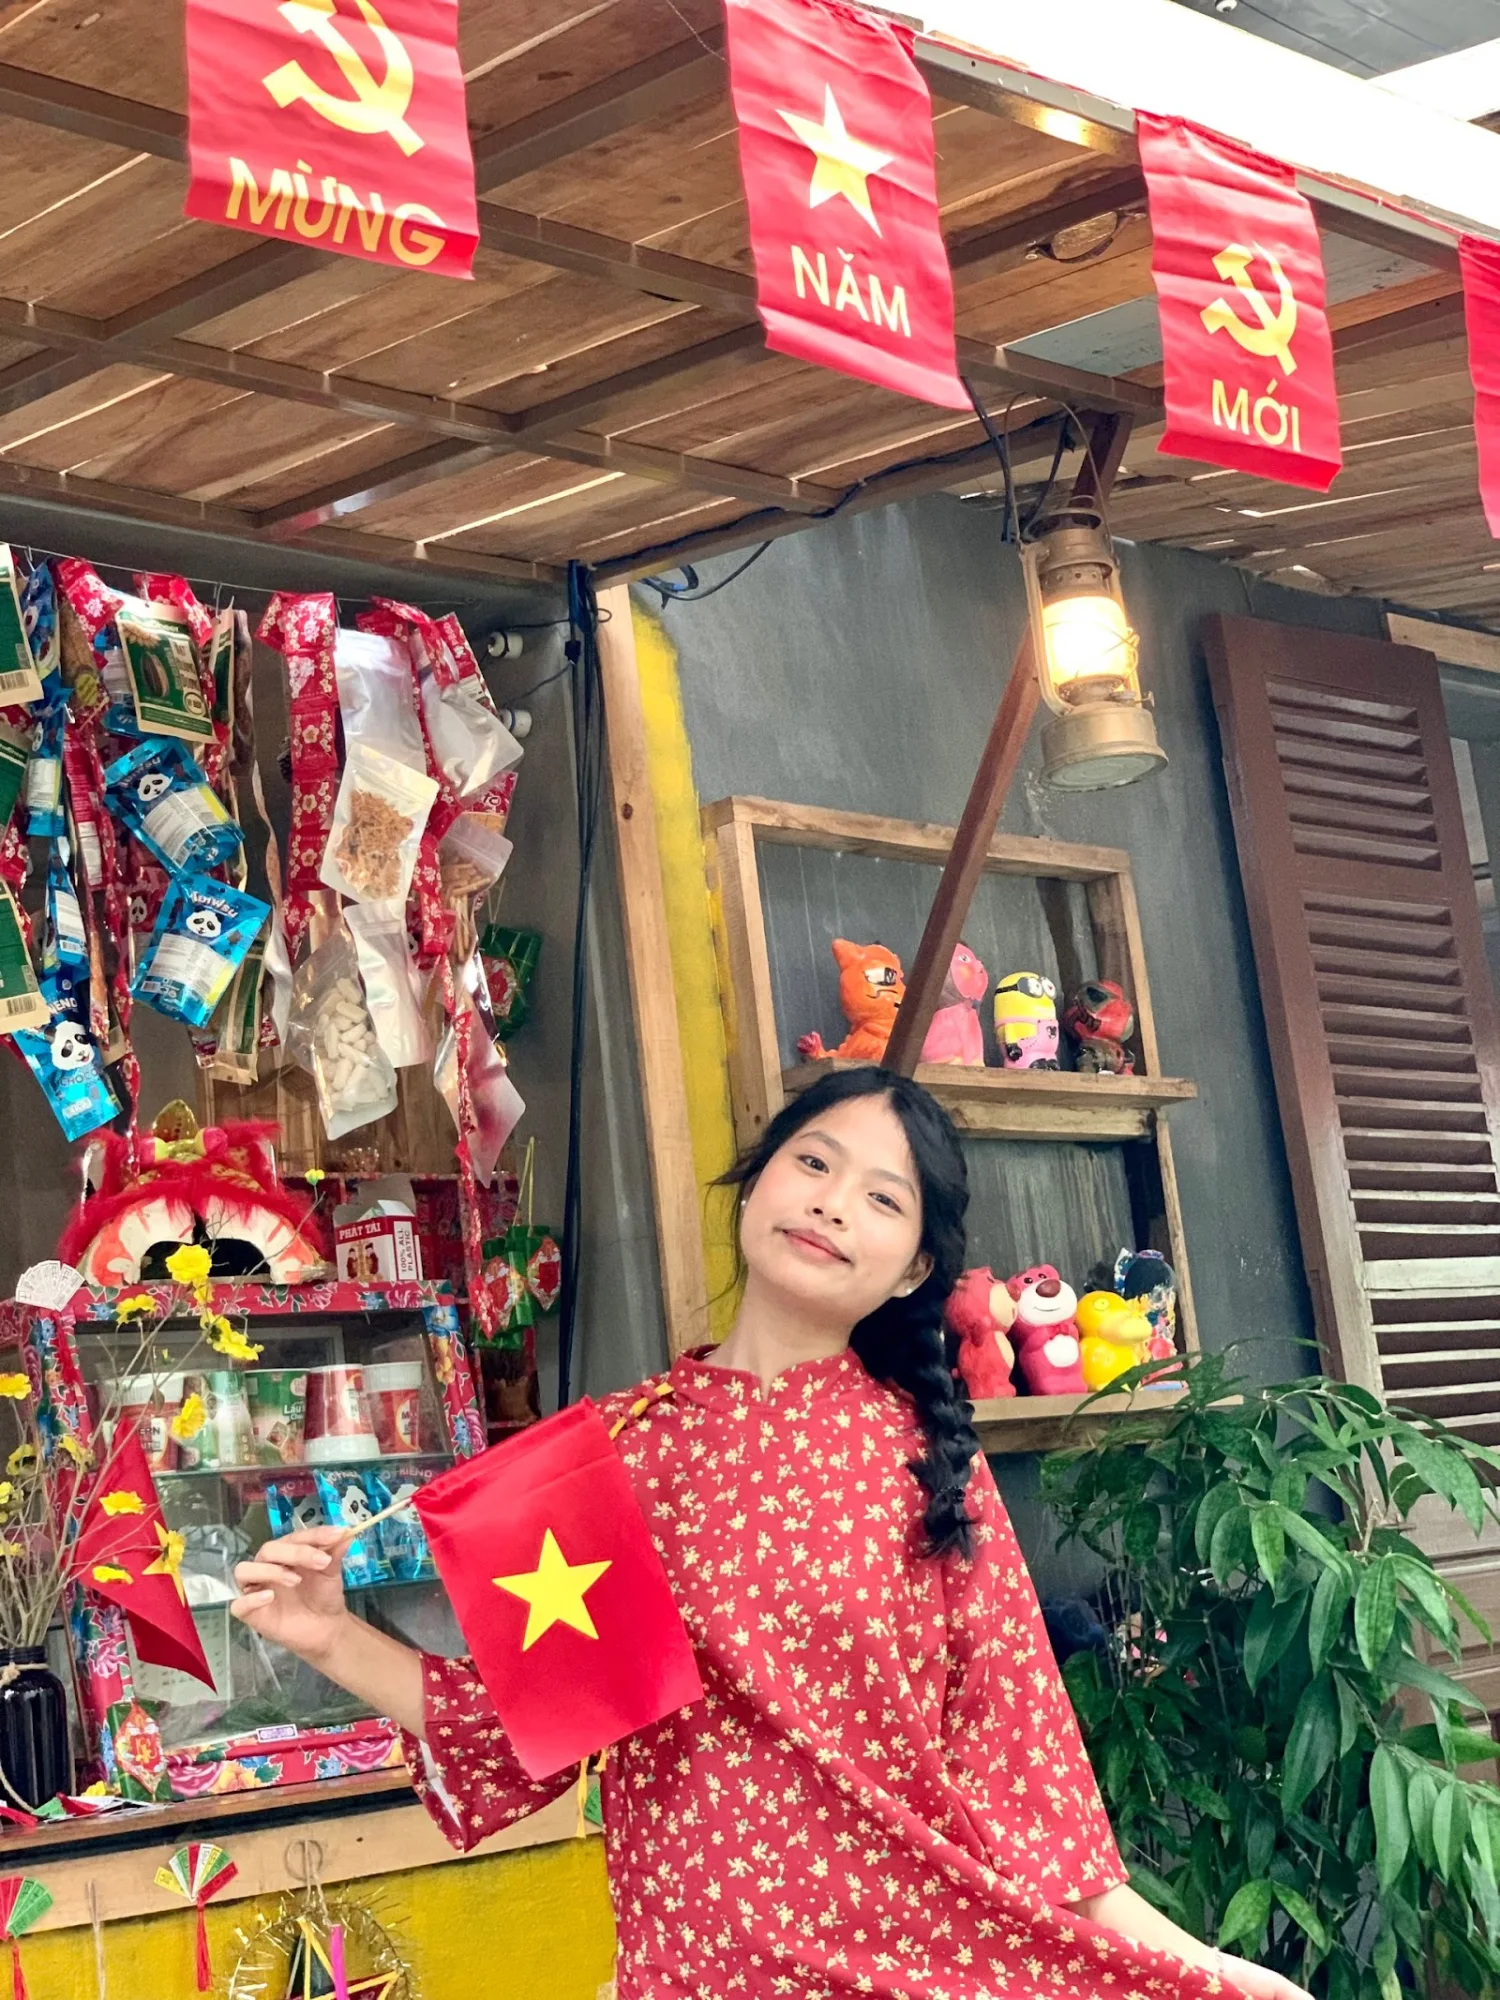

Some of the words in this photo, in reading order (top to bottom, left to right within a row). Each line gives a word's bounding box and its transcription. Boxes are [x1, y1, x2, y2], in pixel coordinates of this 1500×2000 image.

[225, 157, 447, 265] MỪNG
[791, 244, 911, 338] NĂM
[1212, 378, 1301, 453] MỚI
[404, 1230, 414, 1272] PLASTIC
